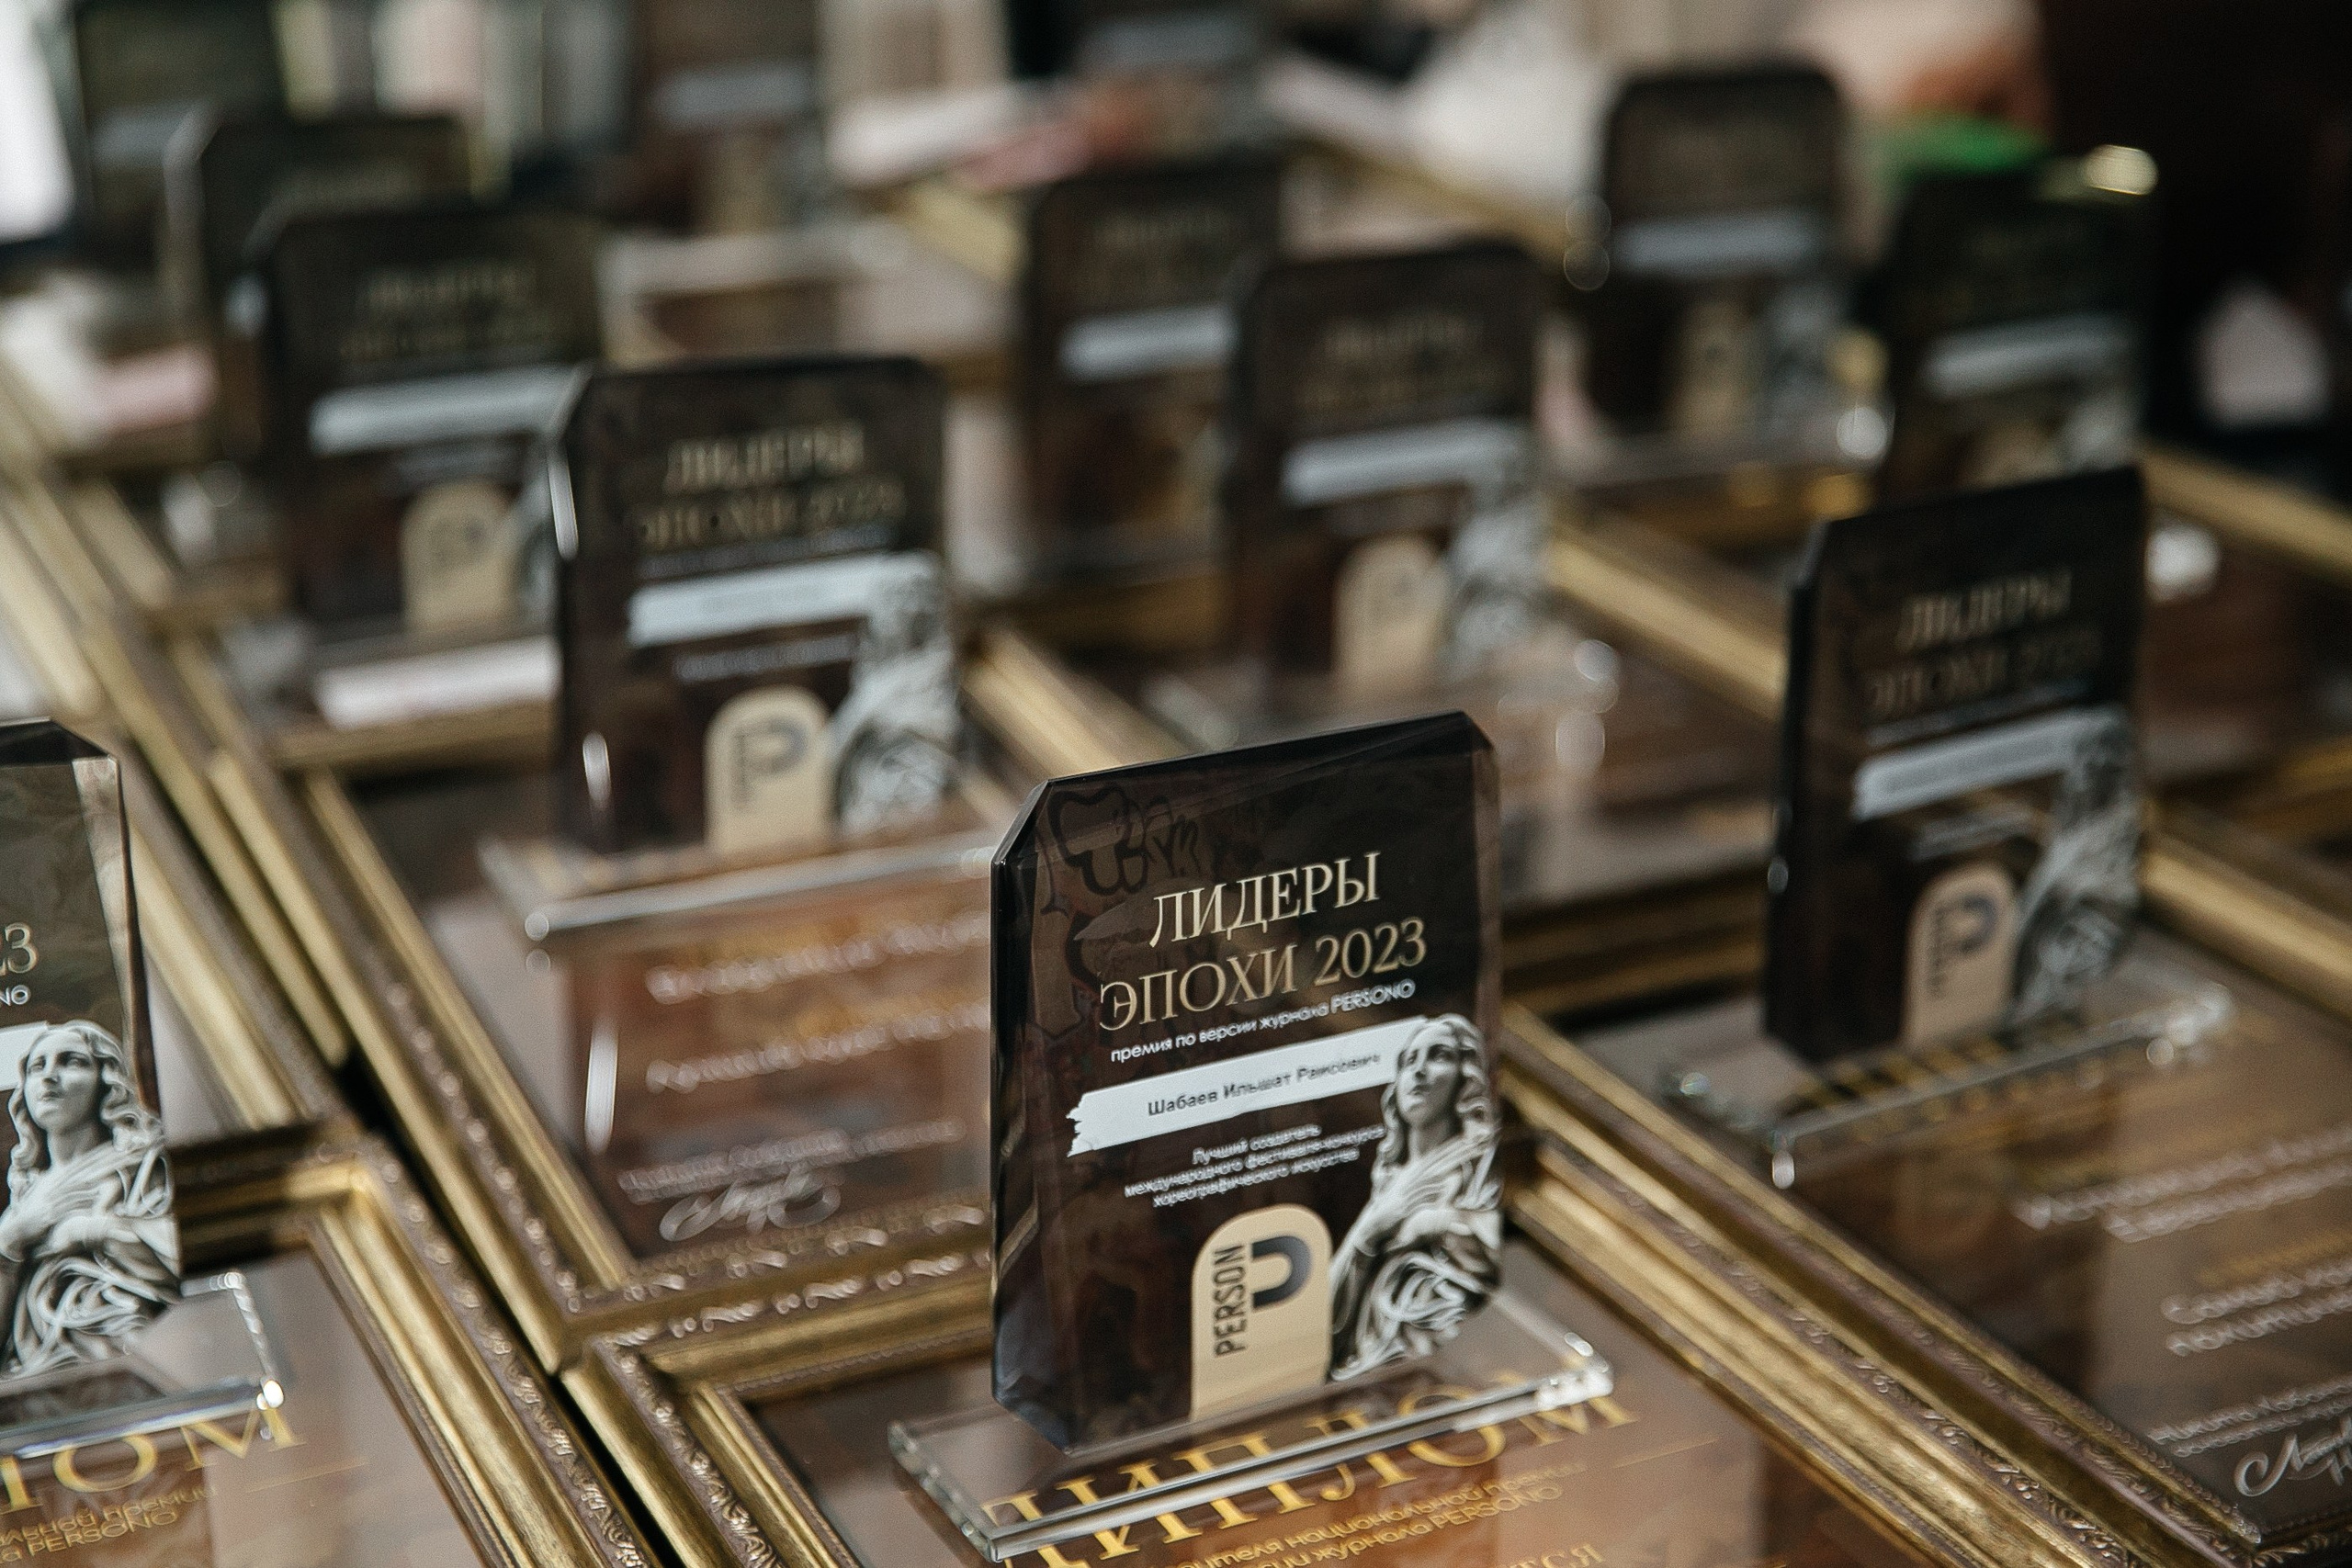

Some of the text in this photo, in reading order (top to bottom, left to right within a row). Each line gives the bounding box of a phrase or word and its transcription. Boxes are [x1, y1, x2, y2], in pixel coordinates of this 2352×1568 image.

[1148, 851, 1381, 948] ЛИДЕРЫ
[0, 922, 39, 976] 3
[1099, 917, 1427, 1031] ЭПОХИ 2023
[1111, 978, 1416, 1063] премия по версии журнала PERSONO
[1148, 1055, 1380, 1116] Шабаев Ильшат Раисович
[1192, 1137, 1248, 1166] Лучший
[1213, 1244, 1248, 1359] PERSON
[0, 1507, 96, 1547] льной
[27, 1509, 178, 1557] PERSONO
[1283, 1482, 1484, 1549] национальной
[1311, 1520, 1435, 1562] журнала
[1430, 1483, 1565, 1530] PERSONO
